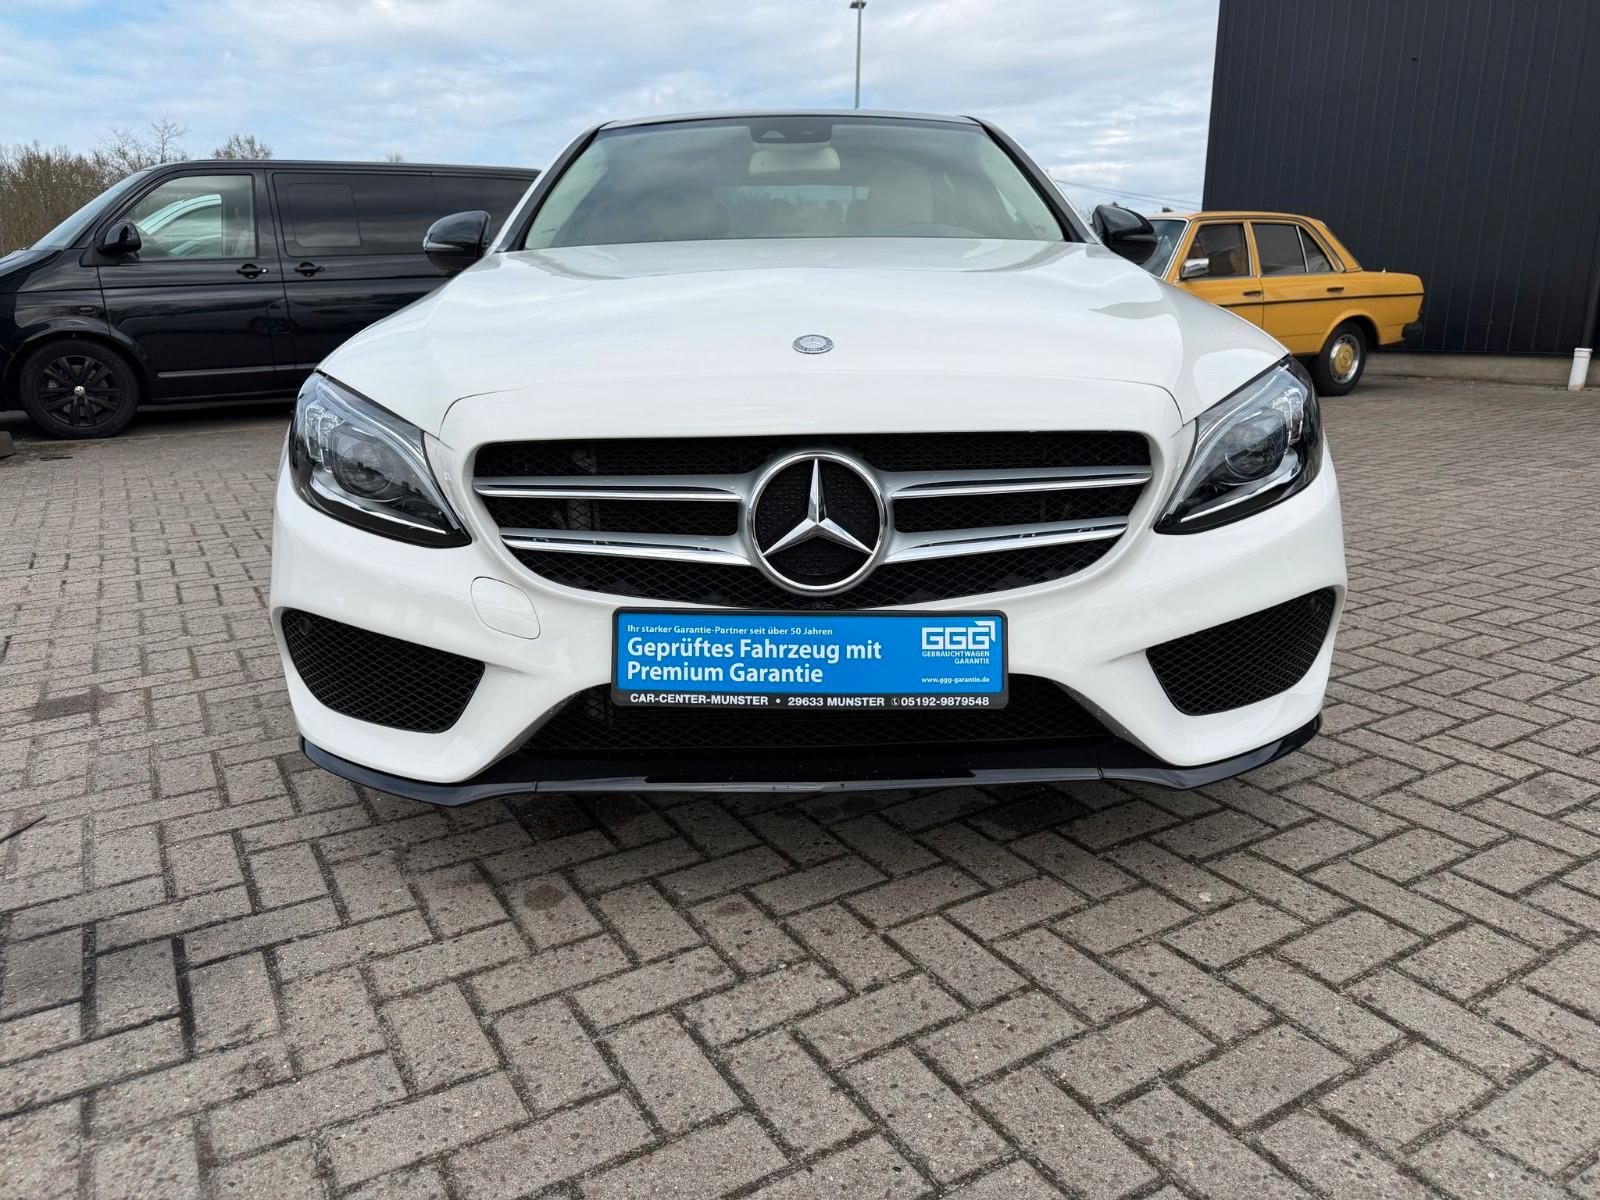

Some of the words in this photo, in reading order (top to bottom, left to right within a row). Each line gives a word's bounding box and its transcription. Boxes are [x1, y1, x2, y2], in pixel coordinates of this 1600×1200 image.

[627, 625, 640, 633] Ihr
[641, 625, 672, 634] starker
[673, 626, 747, 635] Garantie-Partner
[749, 627, 765, 635] seit
[768, 627, 788, 635] über
[791, 627, 801, 635] 50
[803, 627, 833, 636] Jahren
[921, 627, 990, 650] GGG
[627, 637, 734, 662] Geprüftes
[740, 639, 840, 664] Fahrzeug
[846, 640, 882, 660] mit
[627, 661, 724, 682] Premium
[729, 663, 824, 683] Garantie
[921, 676, 990, 684] www.ggg-garantie.de
[630, 693, 769, 706] CAR-CENTER-MUNSTER
[787, 696, 824, 707] 29633
[827, 697, 885, 707] MUNSTER
[901, 696, 990, 707] 05192-9879548
